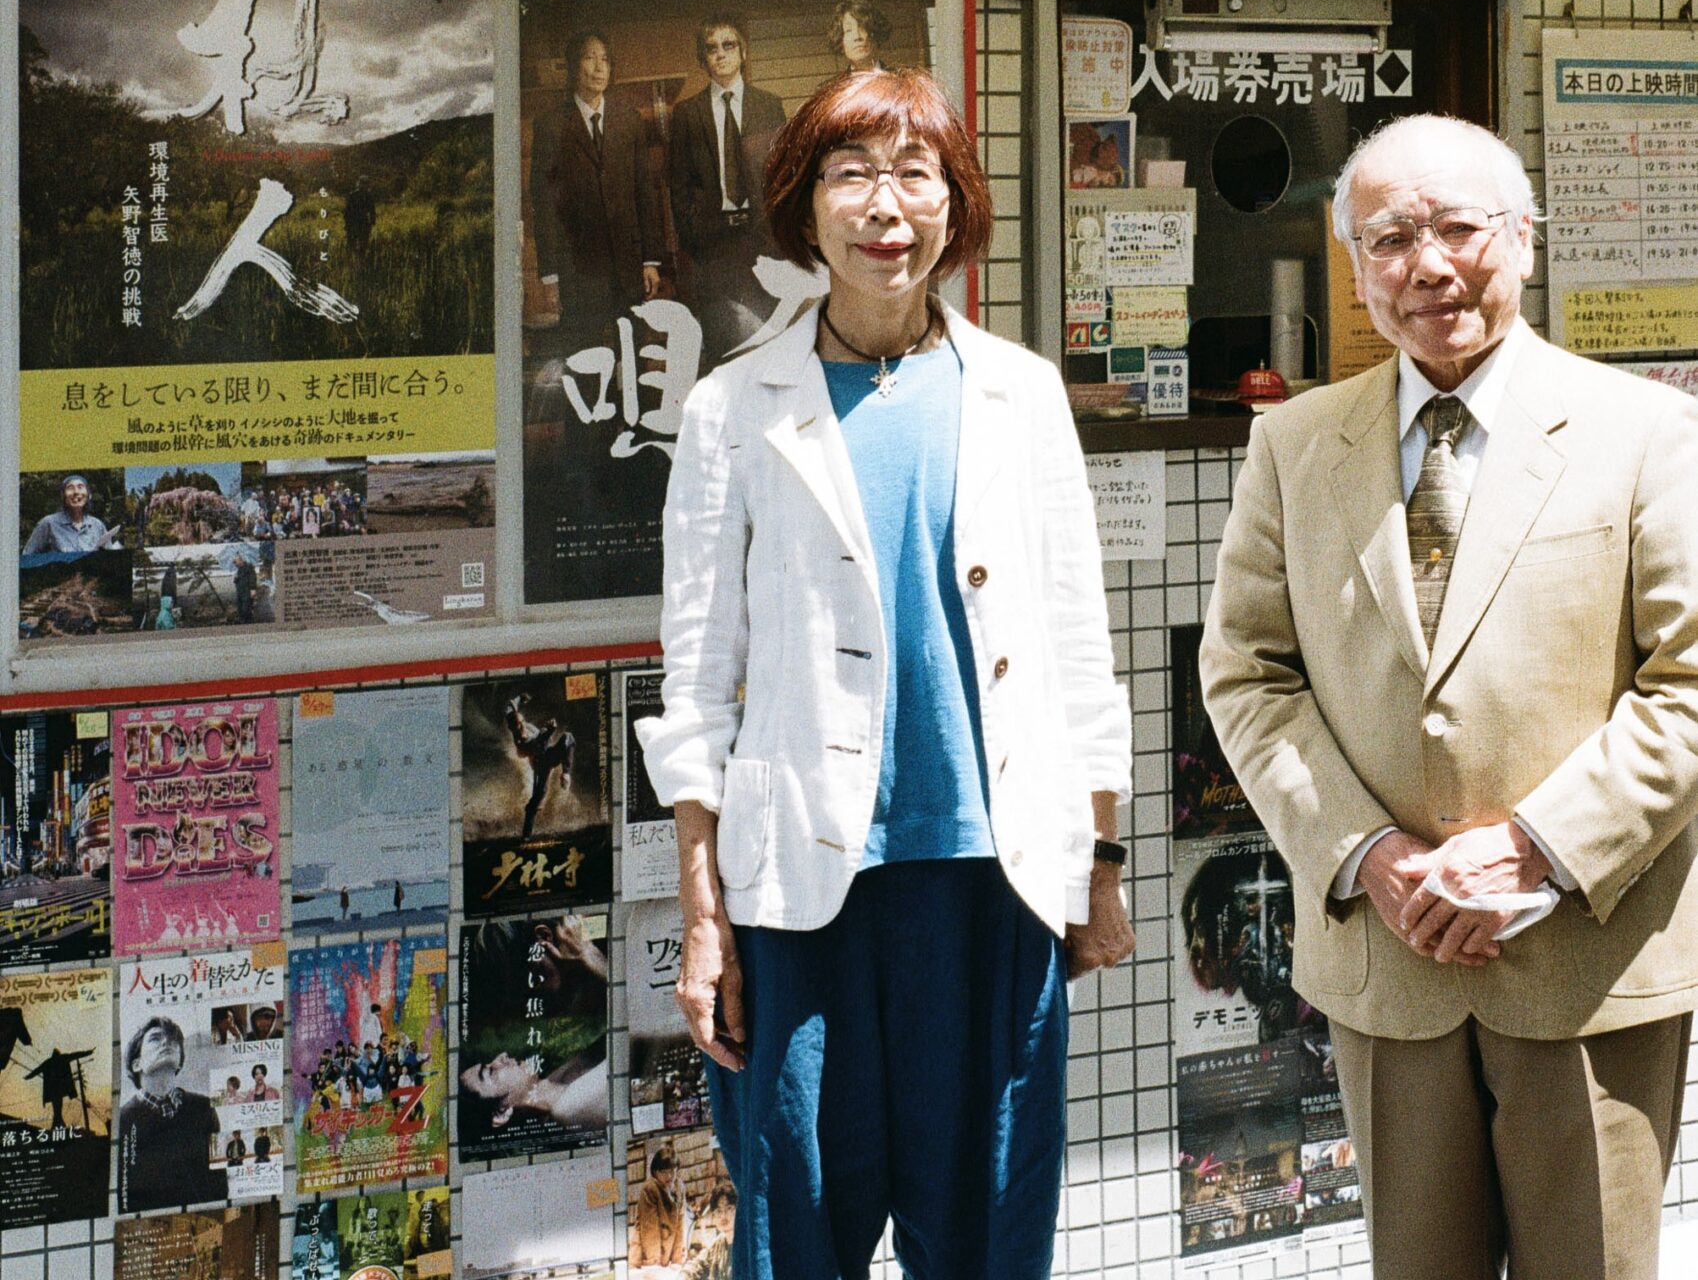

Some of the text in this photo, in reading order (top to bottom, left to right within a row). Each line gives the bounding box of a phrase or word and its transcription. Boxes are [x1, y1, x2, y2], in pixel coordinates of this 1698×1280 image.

[1131, 44, 1366, 104] 入場券売場
[148, 140, 170, 243] 環境再生医
[318, 186, 330, 263] もりびと
[121, 184, 143, 328] 矢野智徳の挑戦
[61, 370, 466, 411] 息をしている限り、まだ間に合う。
[1151, 382, 1185, 400] 優待
[111, 428, 416, 454] 環境問題の根幹に風穴をあける奇跡のドキュメンタリー
[127, 409, 399, 435] 風のように草を刈り イノシシのように大地を掘って
[122, 713, 274, 780] IDOL
[134, 771, 260, 815] NEVER
[231, 1040, 281, 1056] MISSING
